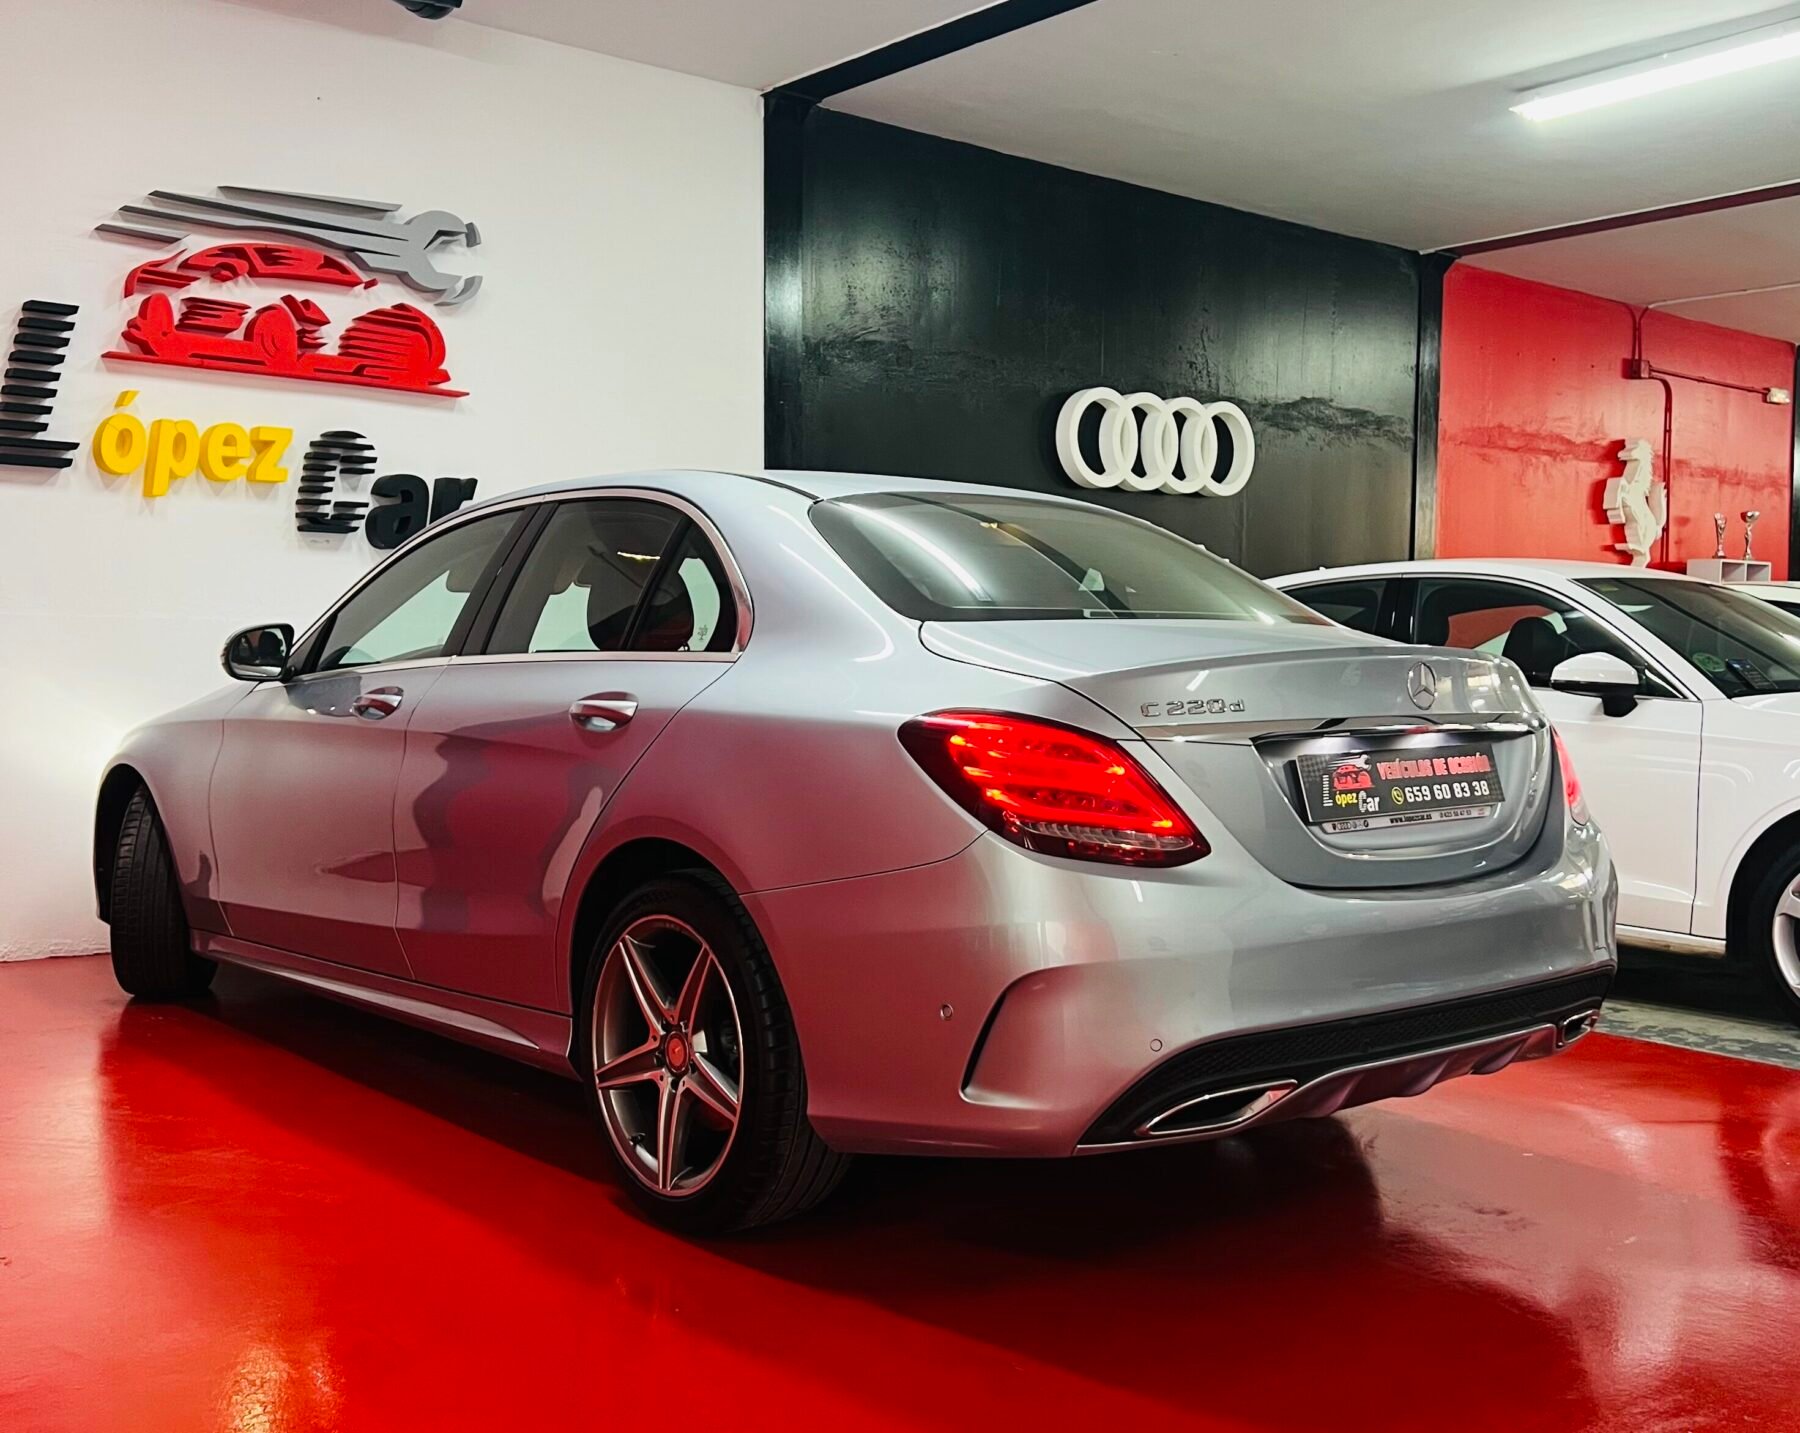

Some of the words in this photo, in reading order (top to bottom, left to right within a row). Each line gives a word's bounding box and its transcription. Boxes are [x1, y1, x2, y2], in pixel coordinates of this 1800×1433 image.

[295, 430, 478, 550] Car
[1432, 757, 1448, 776] DE
[1404, 784, 1431, 803] 659
[1435, 783, 1451, 800] 60
[1454, 782, 1471, 798] 83
[1474, 780, 1490, 796] 38
